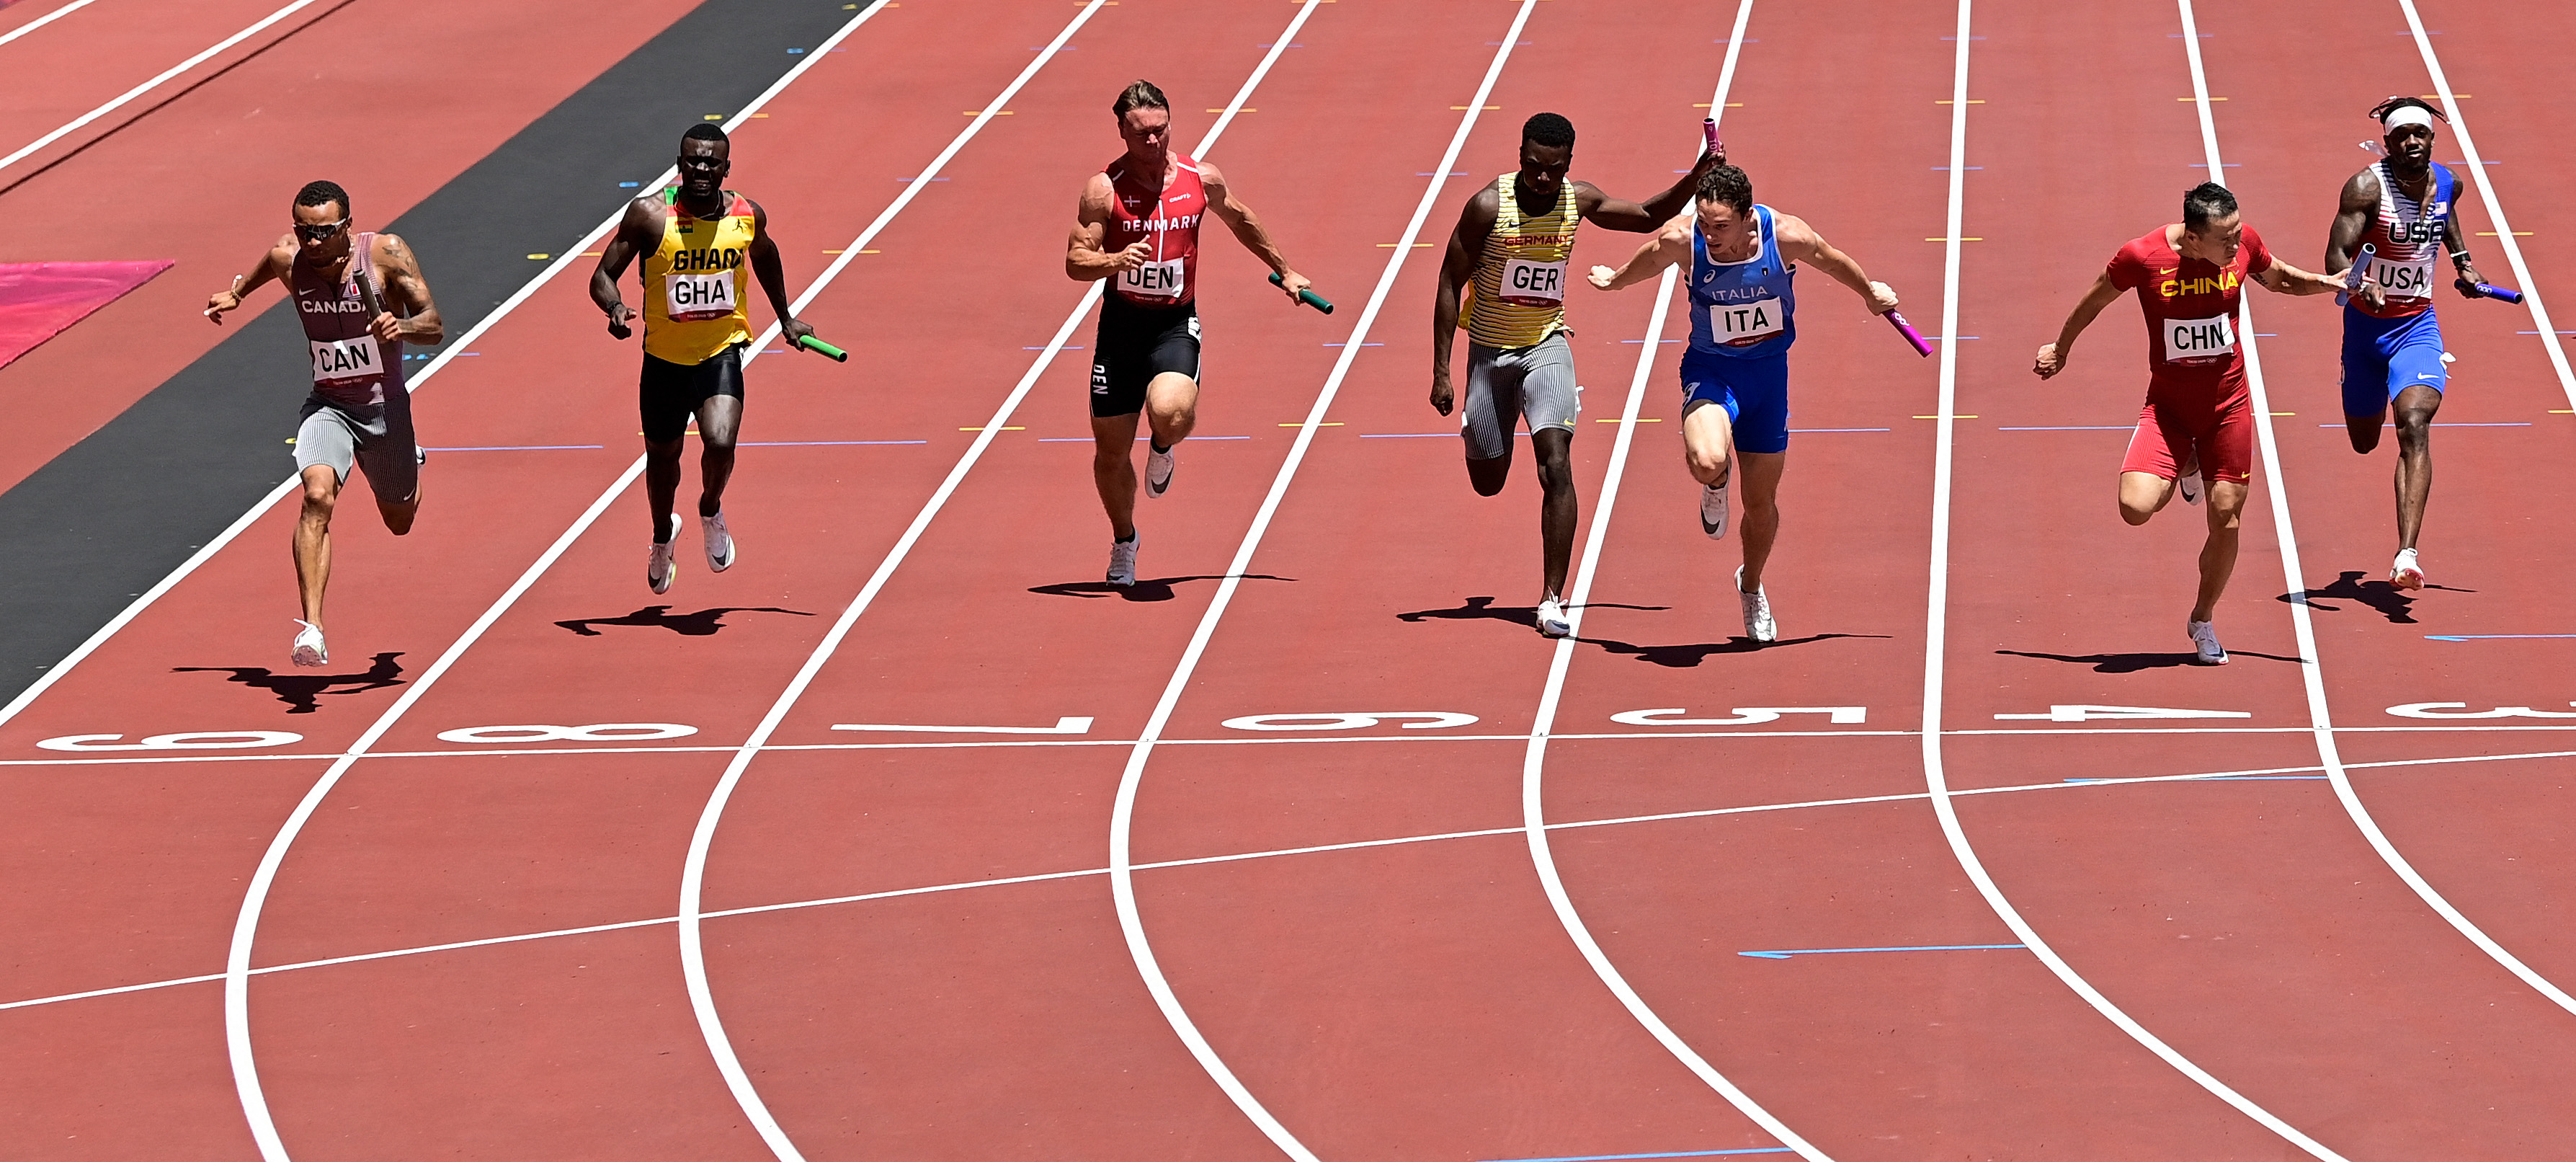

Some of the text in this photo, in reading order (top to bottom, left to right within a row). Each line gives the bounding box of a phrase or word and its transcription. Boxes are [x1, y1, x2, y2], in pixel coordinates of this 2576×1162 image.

[1123, 214, 1199, 231] DENMARK
[2389, 219, 2444, 243] USA
[1504, 234, 1568, 246] GERMANY
[1127, 266, 1173, 290] DEN
[1513, 265, 1559, 290] GER
[2161, 271, 2238, 297] CHINA
[2379, 264, 2425, 289] USA
[675, 280, 726, 304] GHA
[1712, 285, 1768, 301] ITALIA
[1725, 306, 1769, 332] ITA
[2174, 321, 2225, 350] CHN
[319, 343, 370, 372] CAN
[1092, 363, 1108, 394] DEN
[1221, 711, 1479, 731] 6
[1610, 706, 1867, 726] 5
[1993, 704, 2252, 722] 4
[2385, 701, 2576, 719] 3
[437, 724, 699, 743] 8
[830, 716, 1095, 735] 7
[36, 730, 304, 751] 9
